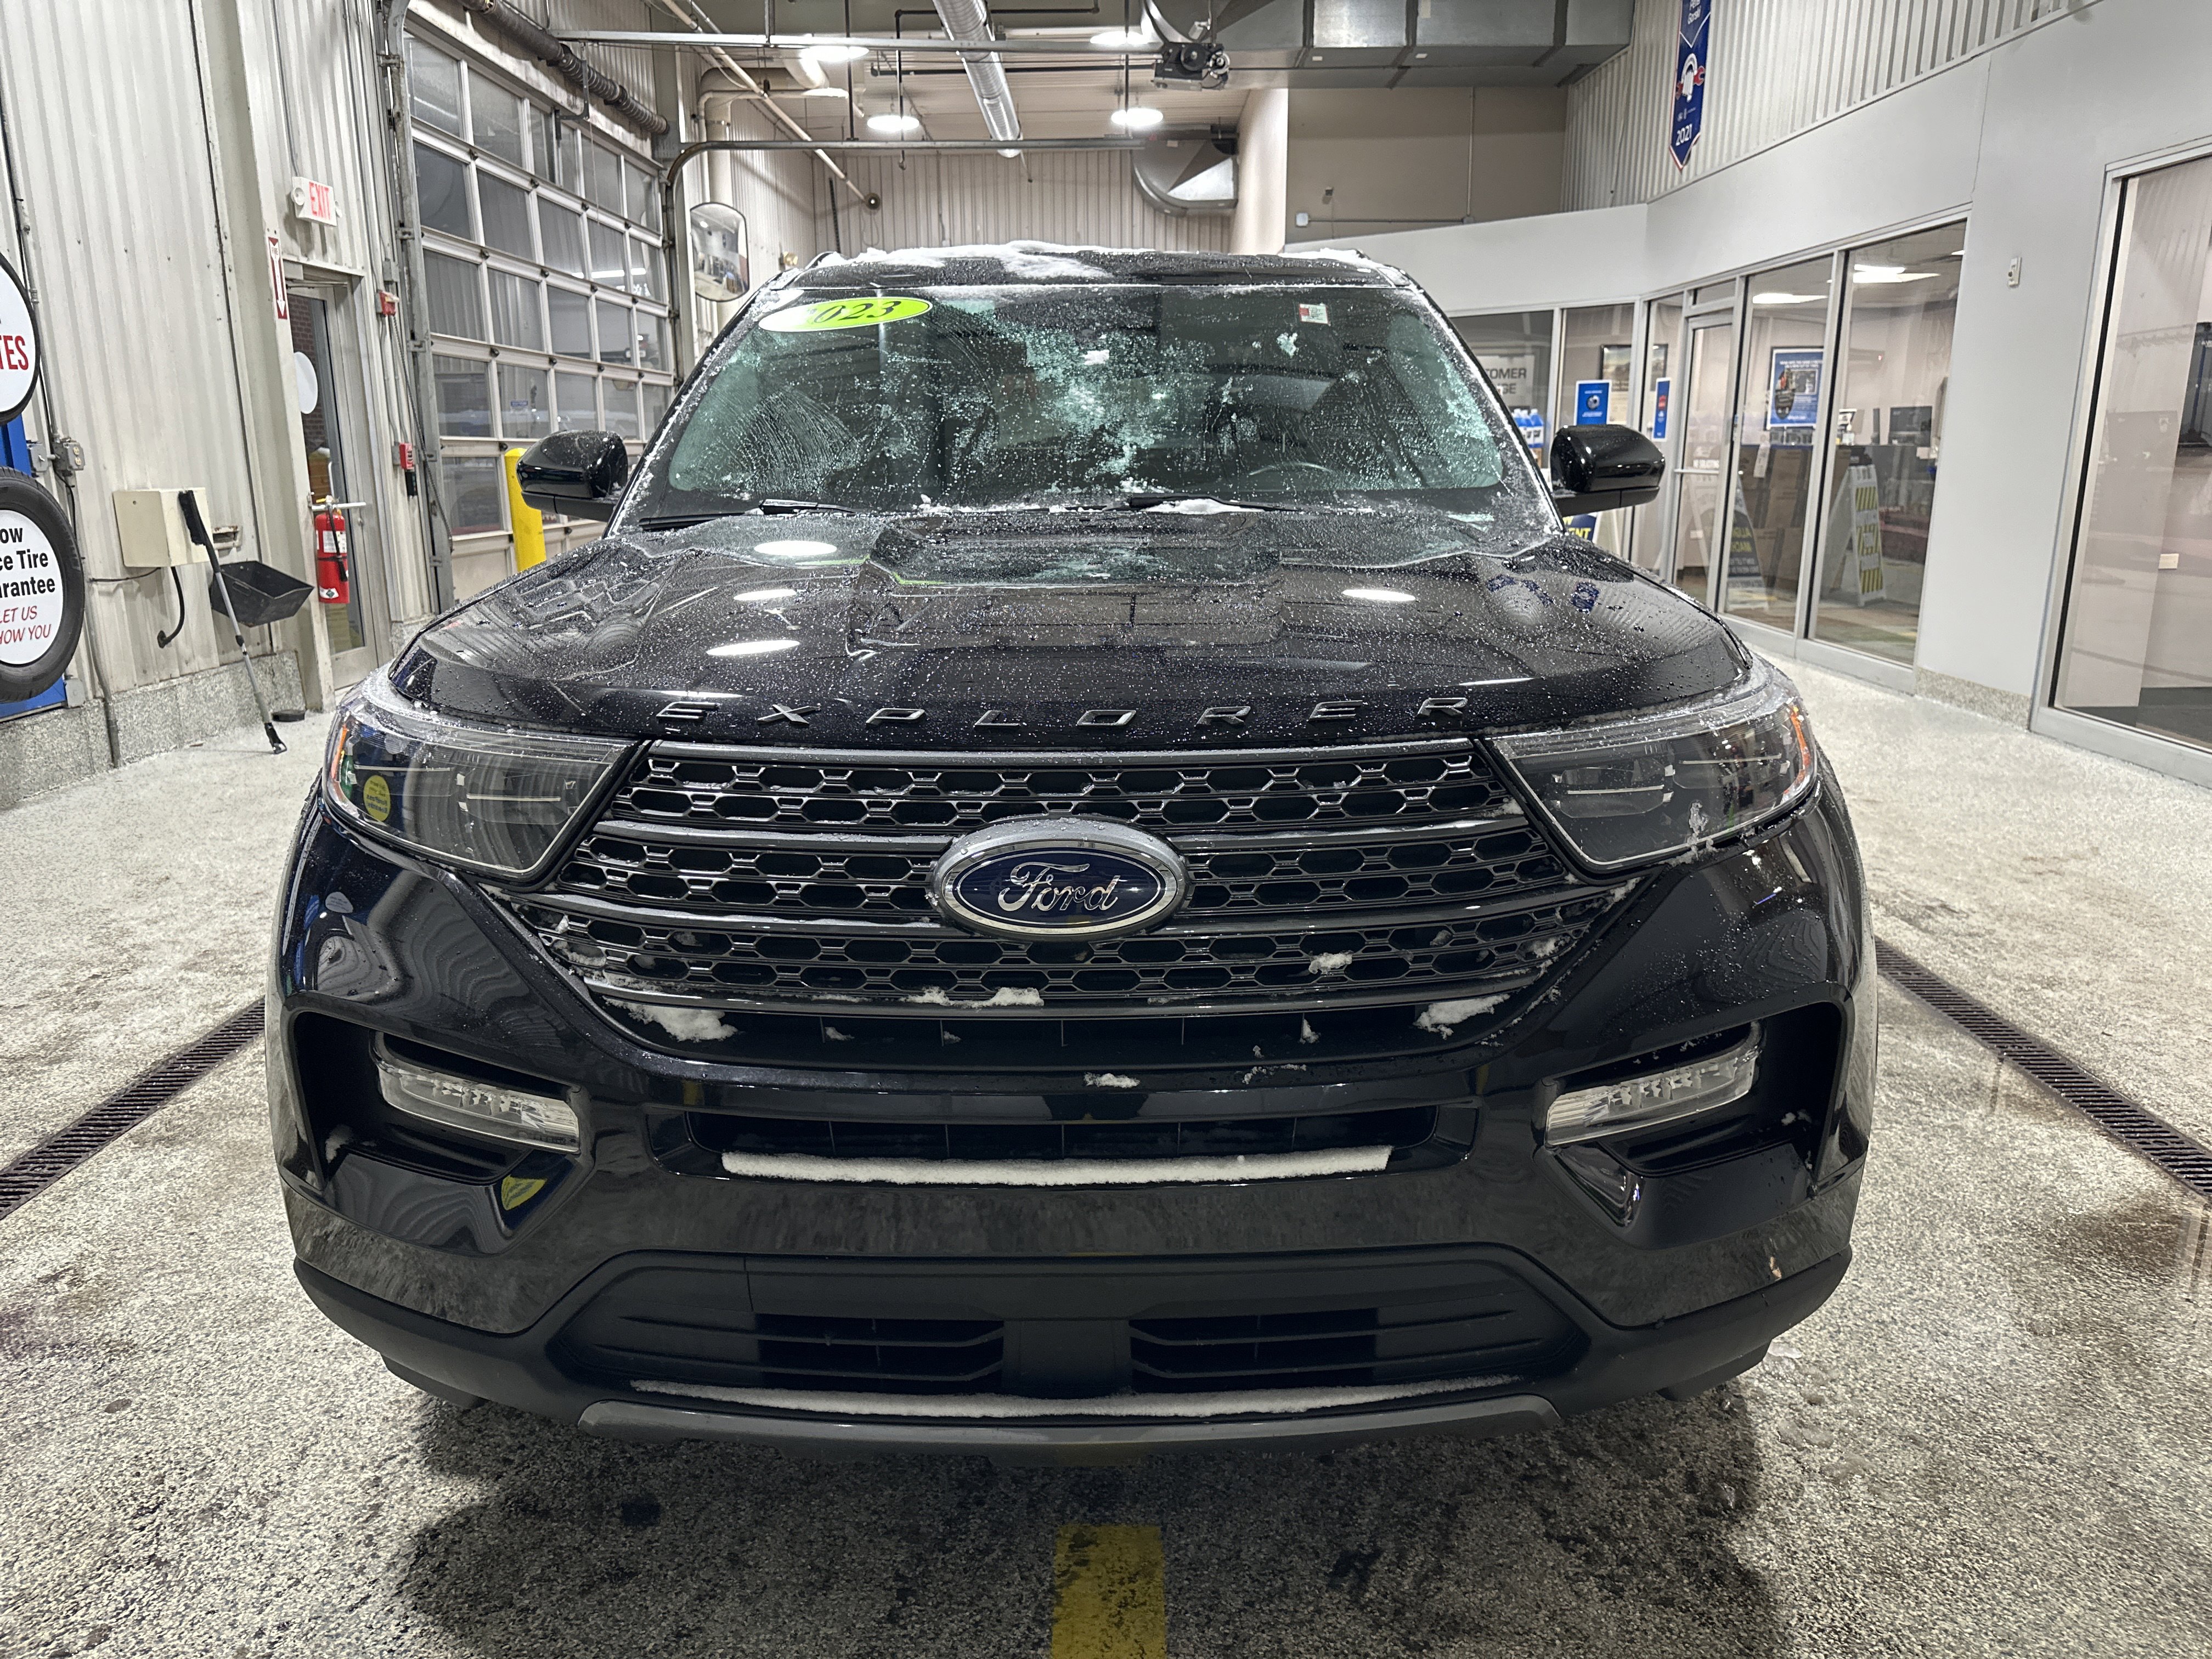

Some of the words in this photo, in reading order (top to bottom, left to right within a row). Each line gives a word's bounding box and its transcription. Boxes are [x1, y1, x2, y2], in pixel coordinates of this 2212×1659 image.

[309, 182, 330, 220] EXIT
[806, 301, 901, 325] 023
[16, 549, 48, 569] Tire
[21, 606, 37, 620] US
[29, 624, 52, 640] YOU
[656, 697, 1469, 726] EXPLORER
[997, 862, 1121, 911] Ford
